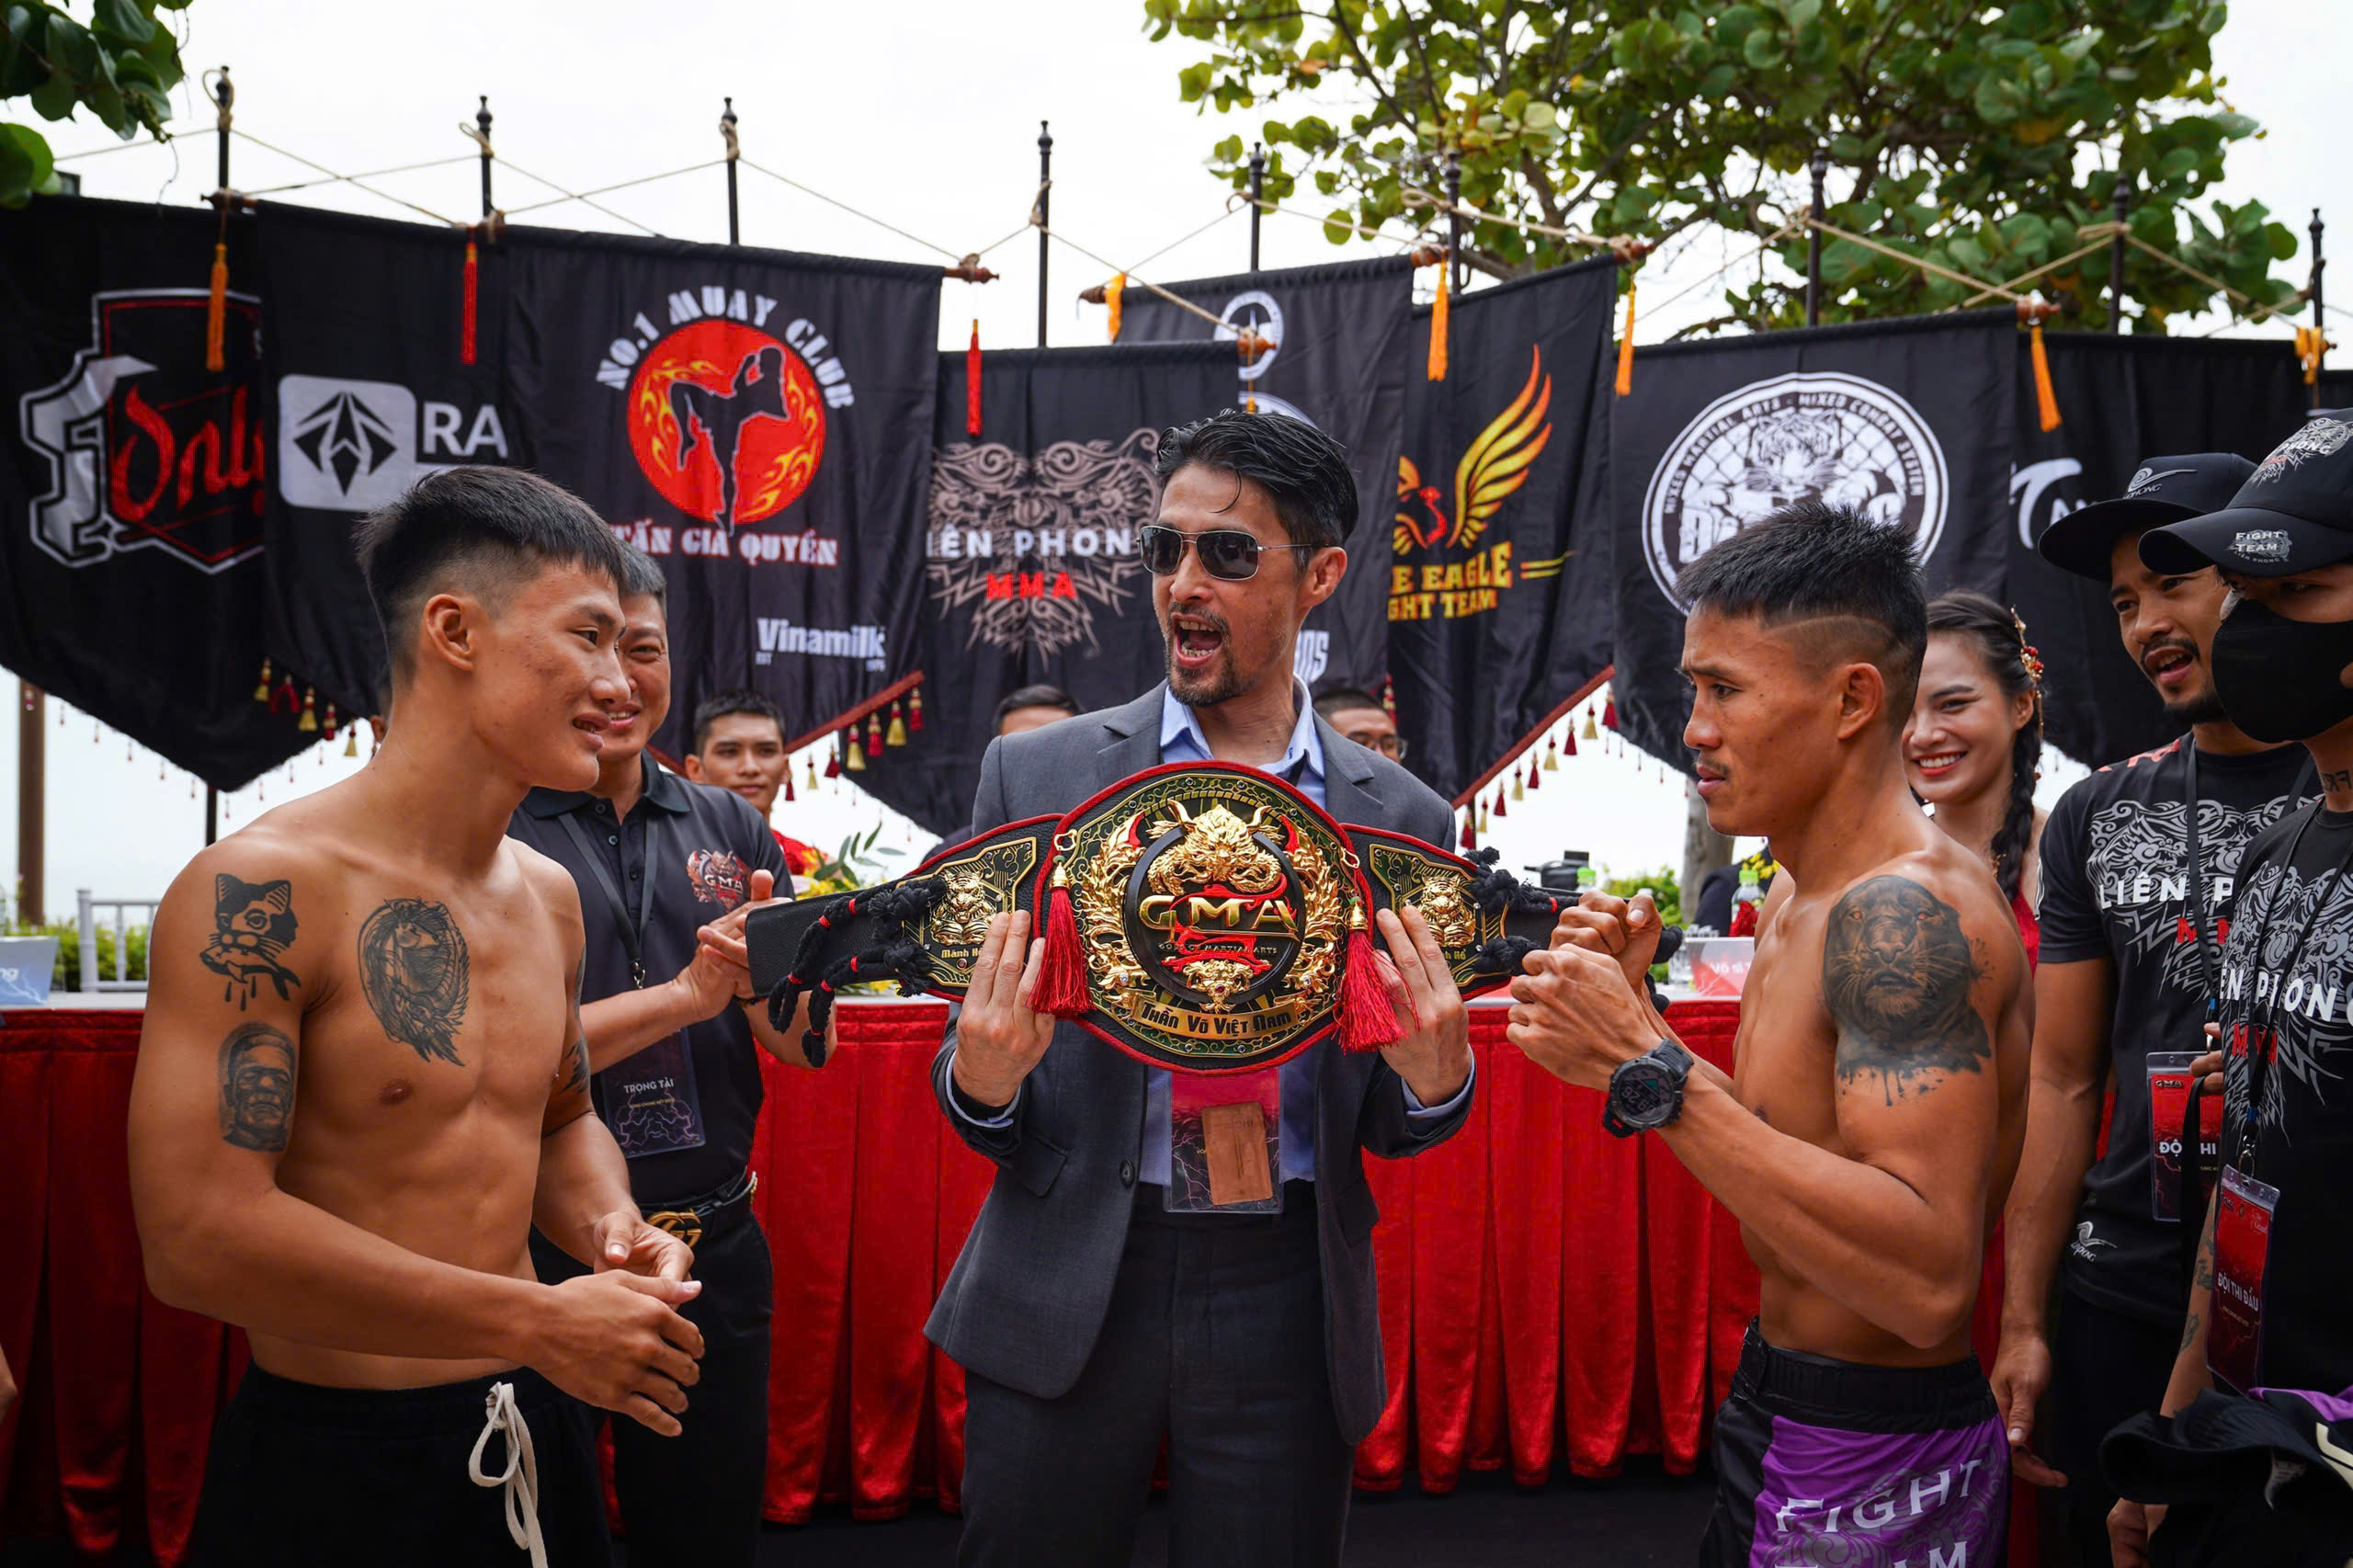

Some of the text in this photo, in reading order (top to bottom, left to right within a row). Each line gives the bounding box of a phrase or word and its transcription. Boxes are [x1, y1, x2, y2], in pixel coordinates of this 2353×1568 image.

[597, 286, 855, 410] NO.1 MUAY CLUB
[1683, 417, 1739, 468] MARTIAL
[1741, 398, 1782, 419] ARTS
[1799, 392, 1847, 408] MIXED
[1851, 398, 1907, 441] COMBAT
[1896, 438, 1924, 496] SYSTEM
[680, 527, 731, 558] GIA
[926, 523, 1131, 558] IÊN PHON
[2235, 531, 2283, 540] FIGHT
[2235, 543, 2278, 551] TEAM
[1421, 540, 1513, 589] EAGLE
[985, 571, 1077, 600] MMA
[1387, 588, 1498, 621] GHT TEAM
[756, 617, 887, 659] Vinamilk
[2099, 871, 2188, 910] LIÊN
[1140, 894, 1300, 944] GMA
[2159, 1138, 2217, 1158] ĐỘ HI
[1775, 1459, 1982, 1534] FIGHT
